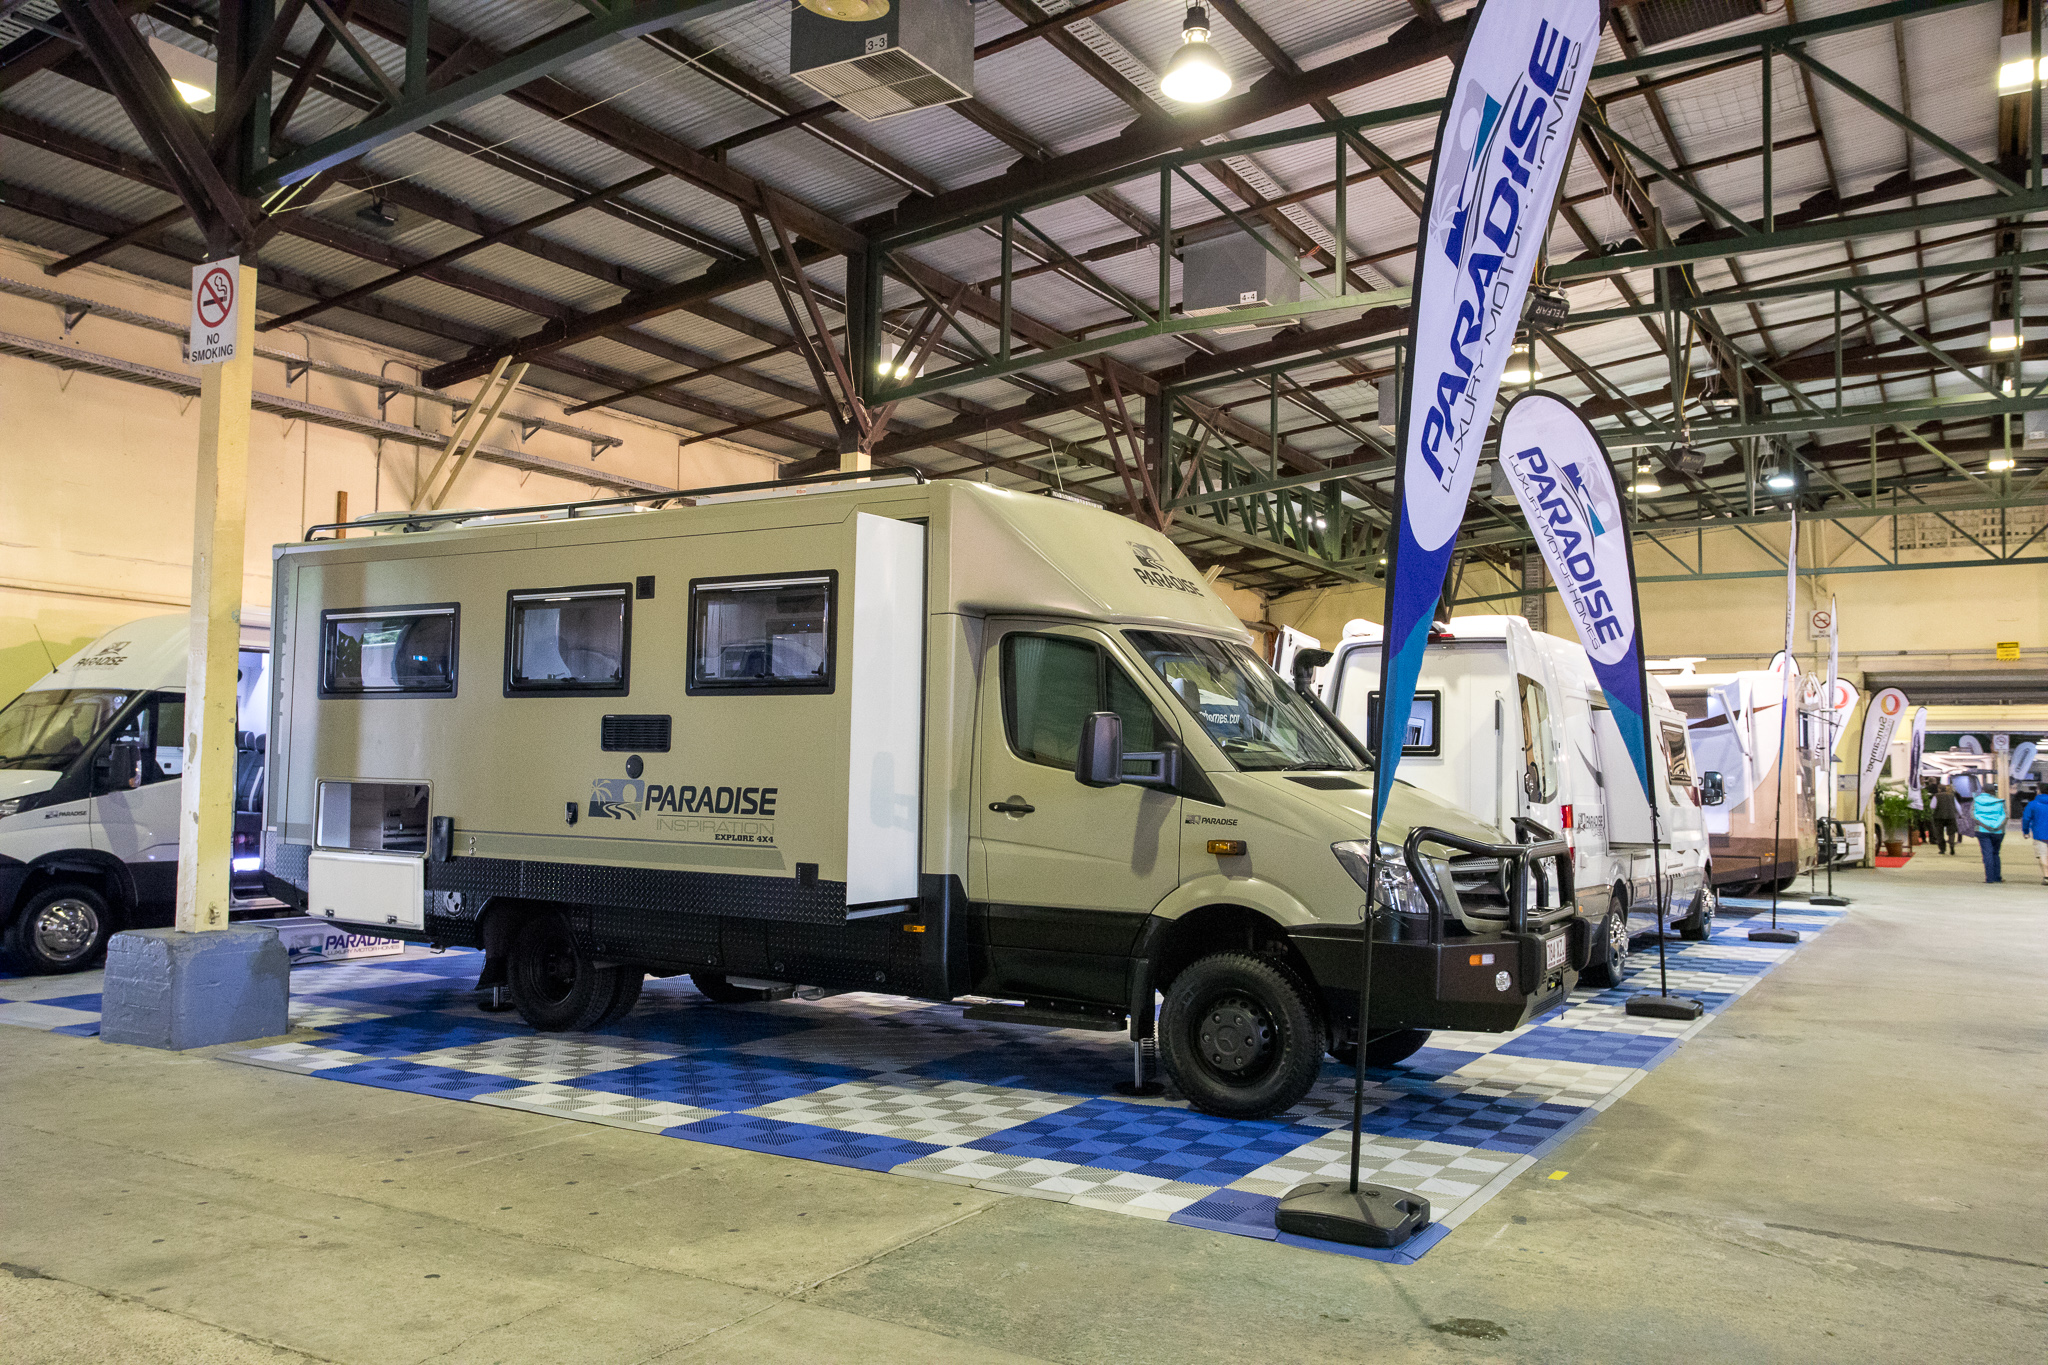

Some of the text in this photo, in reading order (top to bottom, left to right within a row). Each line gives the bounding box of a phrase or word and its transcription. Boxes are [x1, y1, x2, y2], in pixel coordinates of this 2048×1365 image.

[1420, 17, 1571, 483] PARADISE
[1441, 41, 1582, 493] LUXURY MOTO OMES
[206, 332, 220, 345] NO
[191, 343, 234, 363] SMOKING
[1508, 454, 1601, 651] LUXURY MOTOR HOMES
[1516, 446, 1624, 645] PARADISE
[1132, 567, 1205, 598] PARADISE
[644, 784, 779, 816] PARADISE
[656, 818, 776, 836] INSPIRATION
[1201, 816, 1239, 826] PARADISE
[714, 833, 775, 844] EXPLORE 4X4
[327, 943, 400, 957] LUXURY MOTOR HOMES
